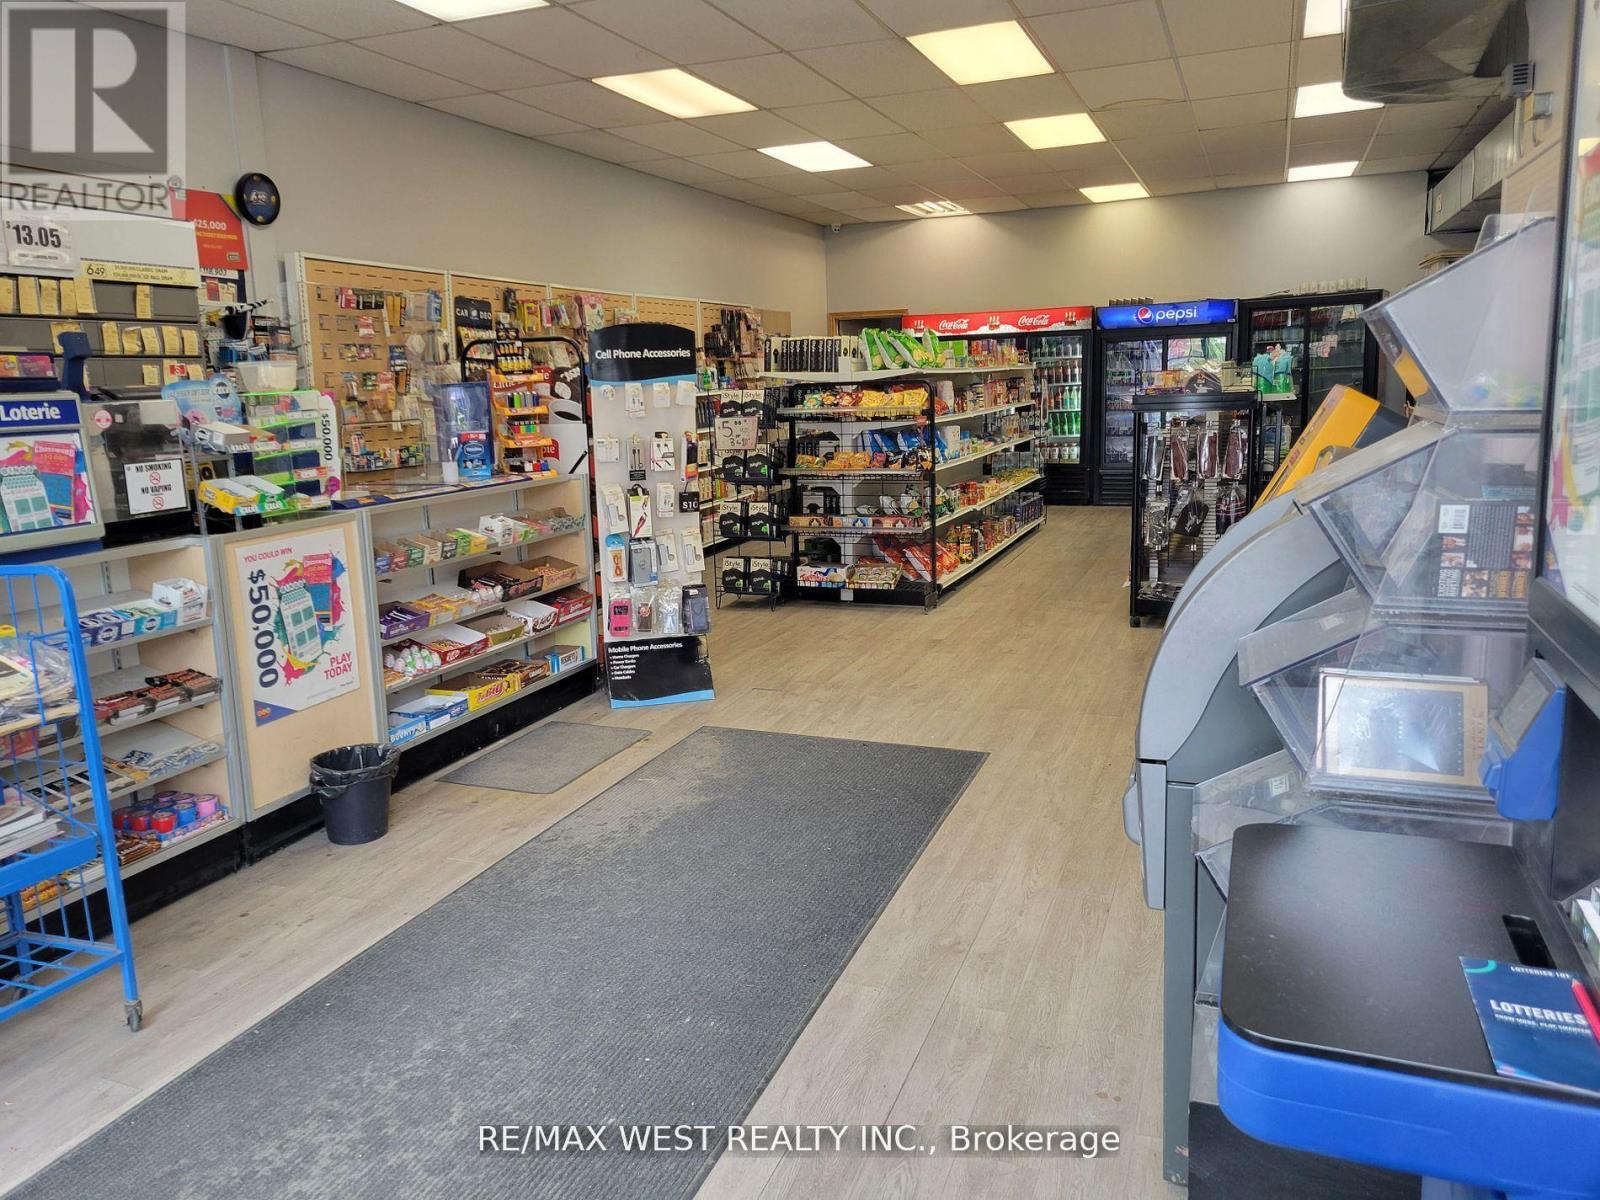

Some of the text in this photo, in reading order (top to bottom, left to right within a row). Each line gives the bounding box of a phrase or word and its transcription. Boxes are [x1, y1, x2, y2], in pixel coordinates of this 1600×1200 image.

[455, 308, 469, 317] CAR
[1156, 306, 1198, 323] pepsi
[595, 347, 691, 359] Cell Phone Accessories
[0, 402, 62, 421] Loterie
[320, 413, 334, 461] $50,000
[135, 463, 172, 473] NO SMOKING
[150, 484, 172, 493] VAPING
[243, 547, 293, 563] YOU COULD WIN
[248, 569, 279, 688] $50,000
[608, 642, 683, 654] Mobile Phone Accessories
[330, 651, 352, 667] PLAY
[324, 662, 353, 680] TODAY
[1510, 965, 1554, 977] LOTTERIES
[1489, 999, 1588, 1026] LOTTERIES
